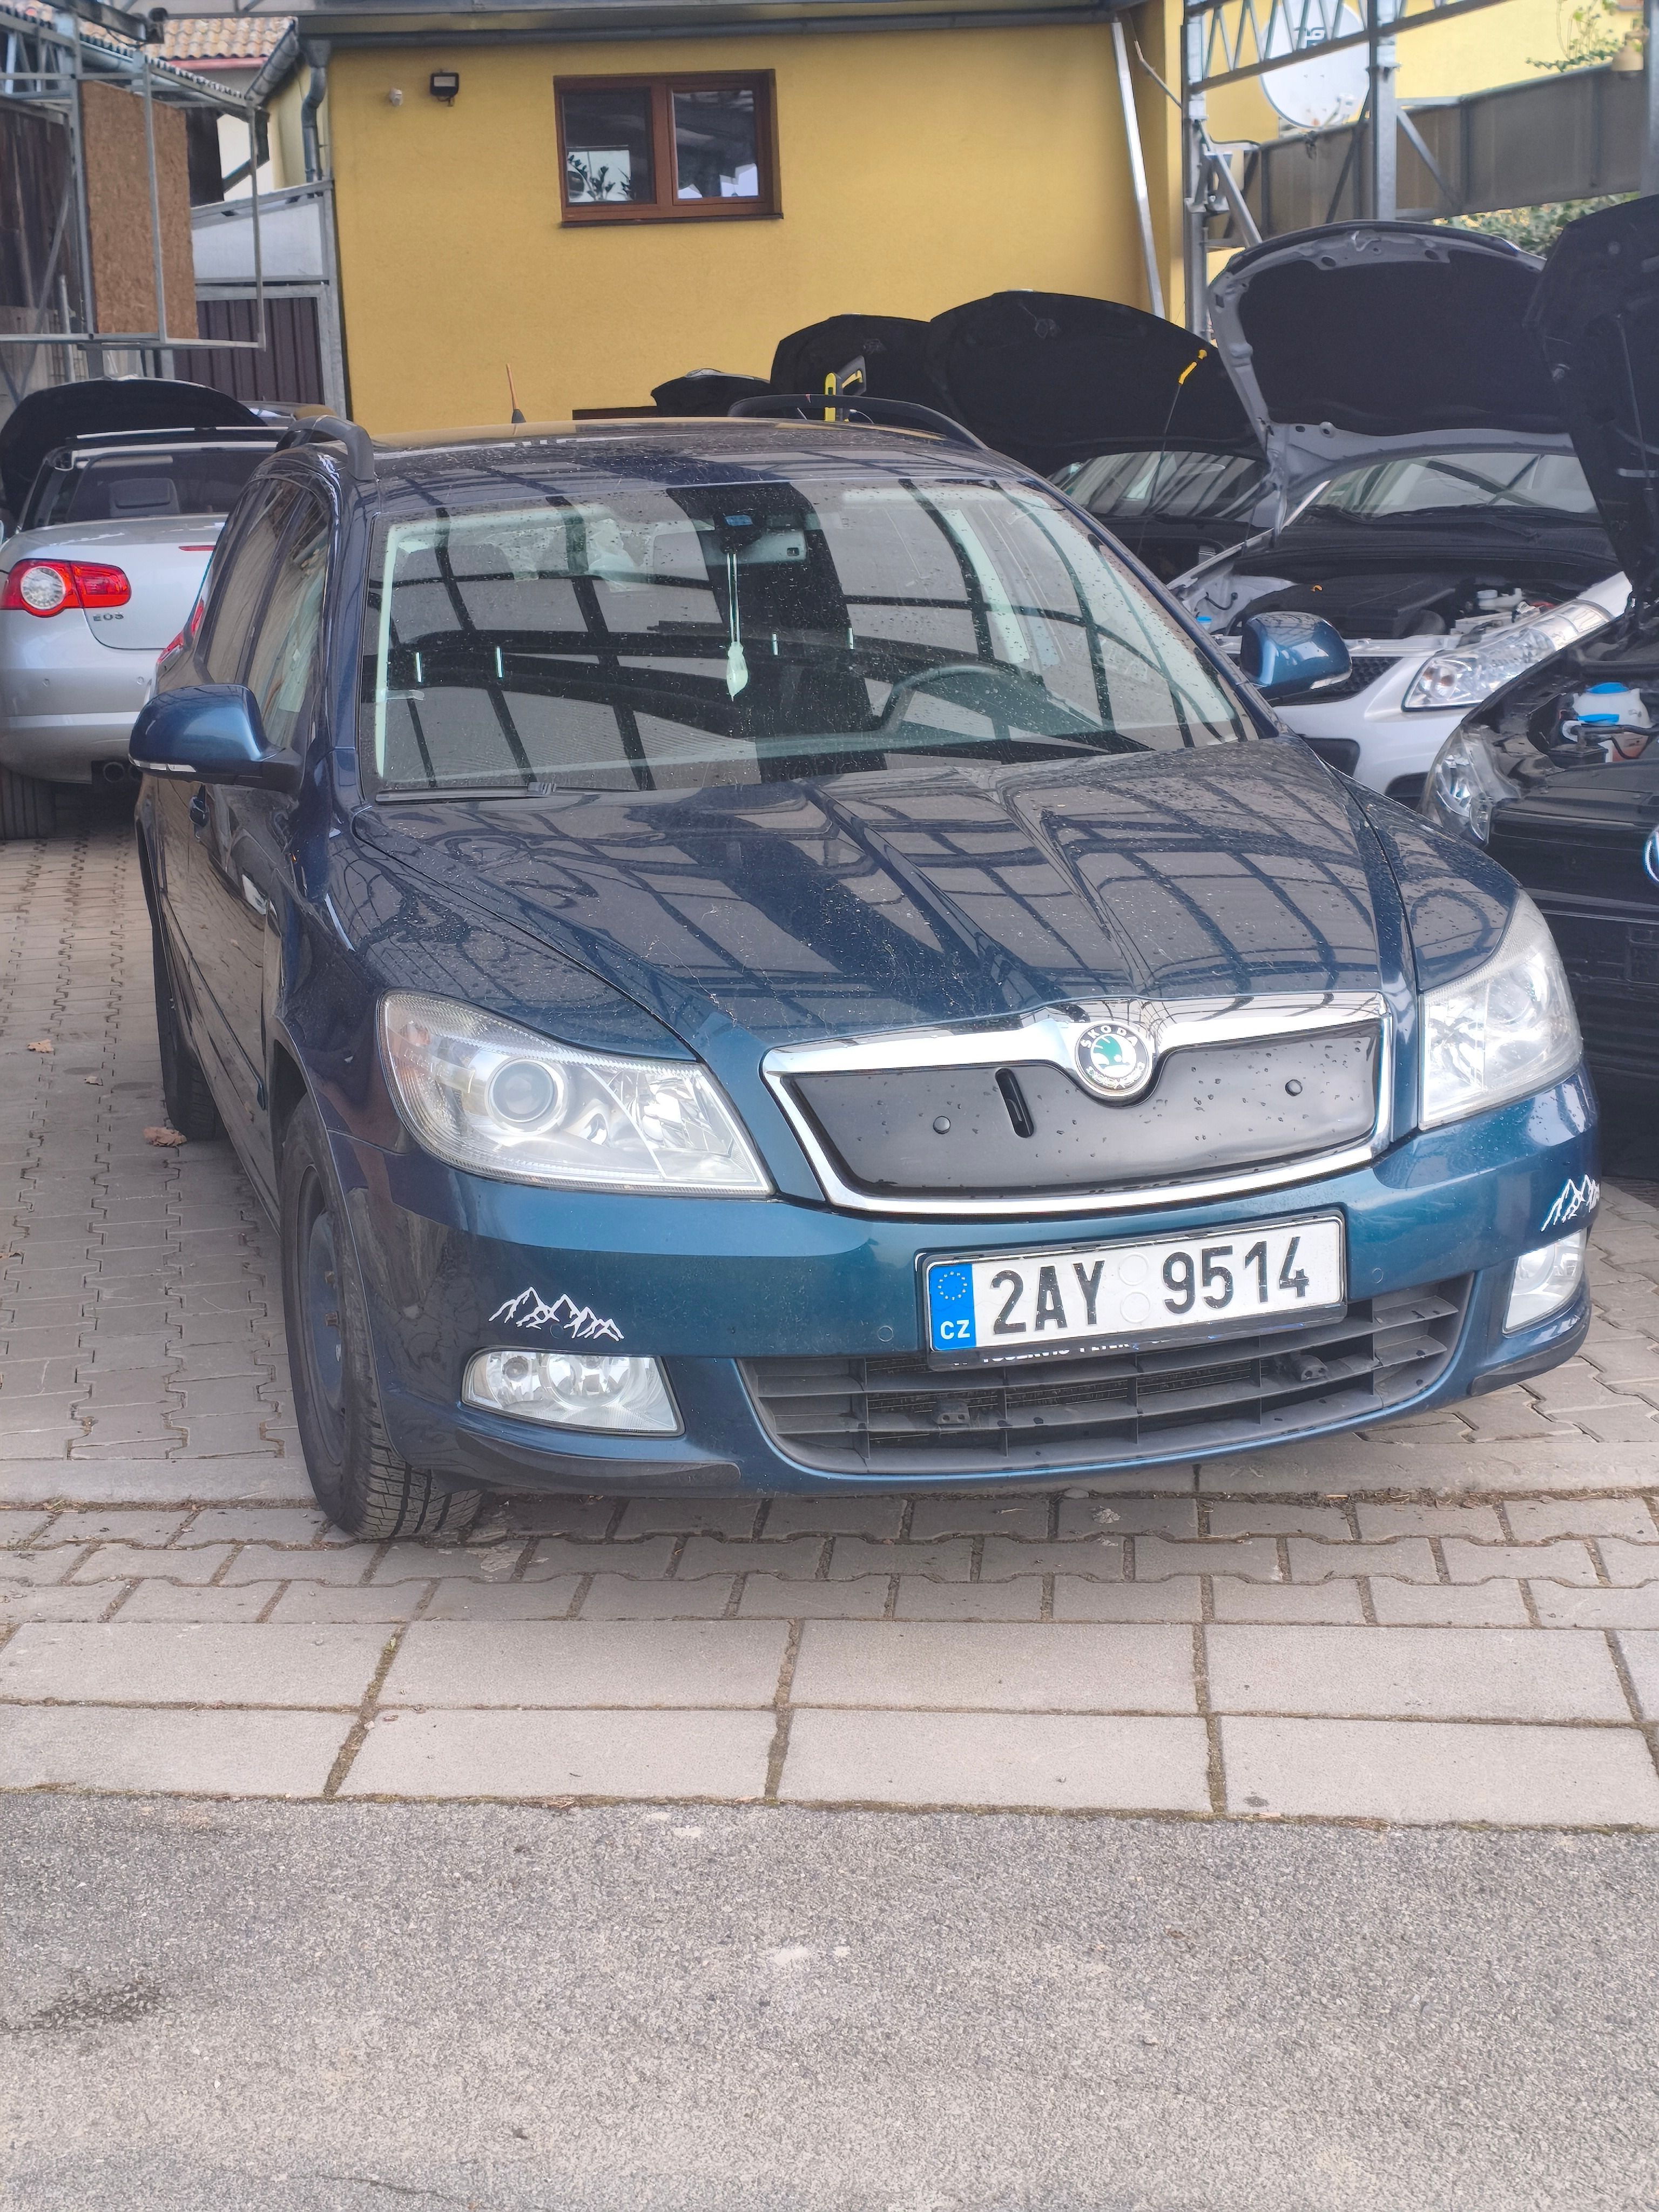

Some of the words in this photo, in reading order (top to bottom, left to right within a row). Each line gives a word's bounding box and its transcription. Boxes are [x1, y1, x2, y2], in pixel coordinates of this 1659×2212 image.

[93, 613, 124, 622] EOS
[990, 1260, 1105, 1335] 2AY
[1162, 1236, 1310, 1315] 9514
[940, 1319, 970, 1340] CZ
